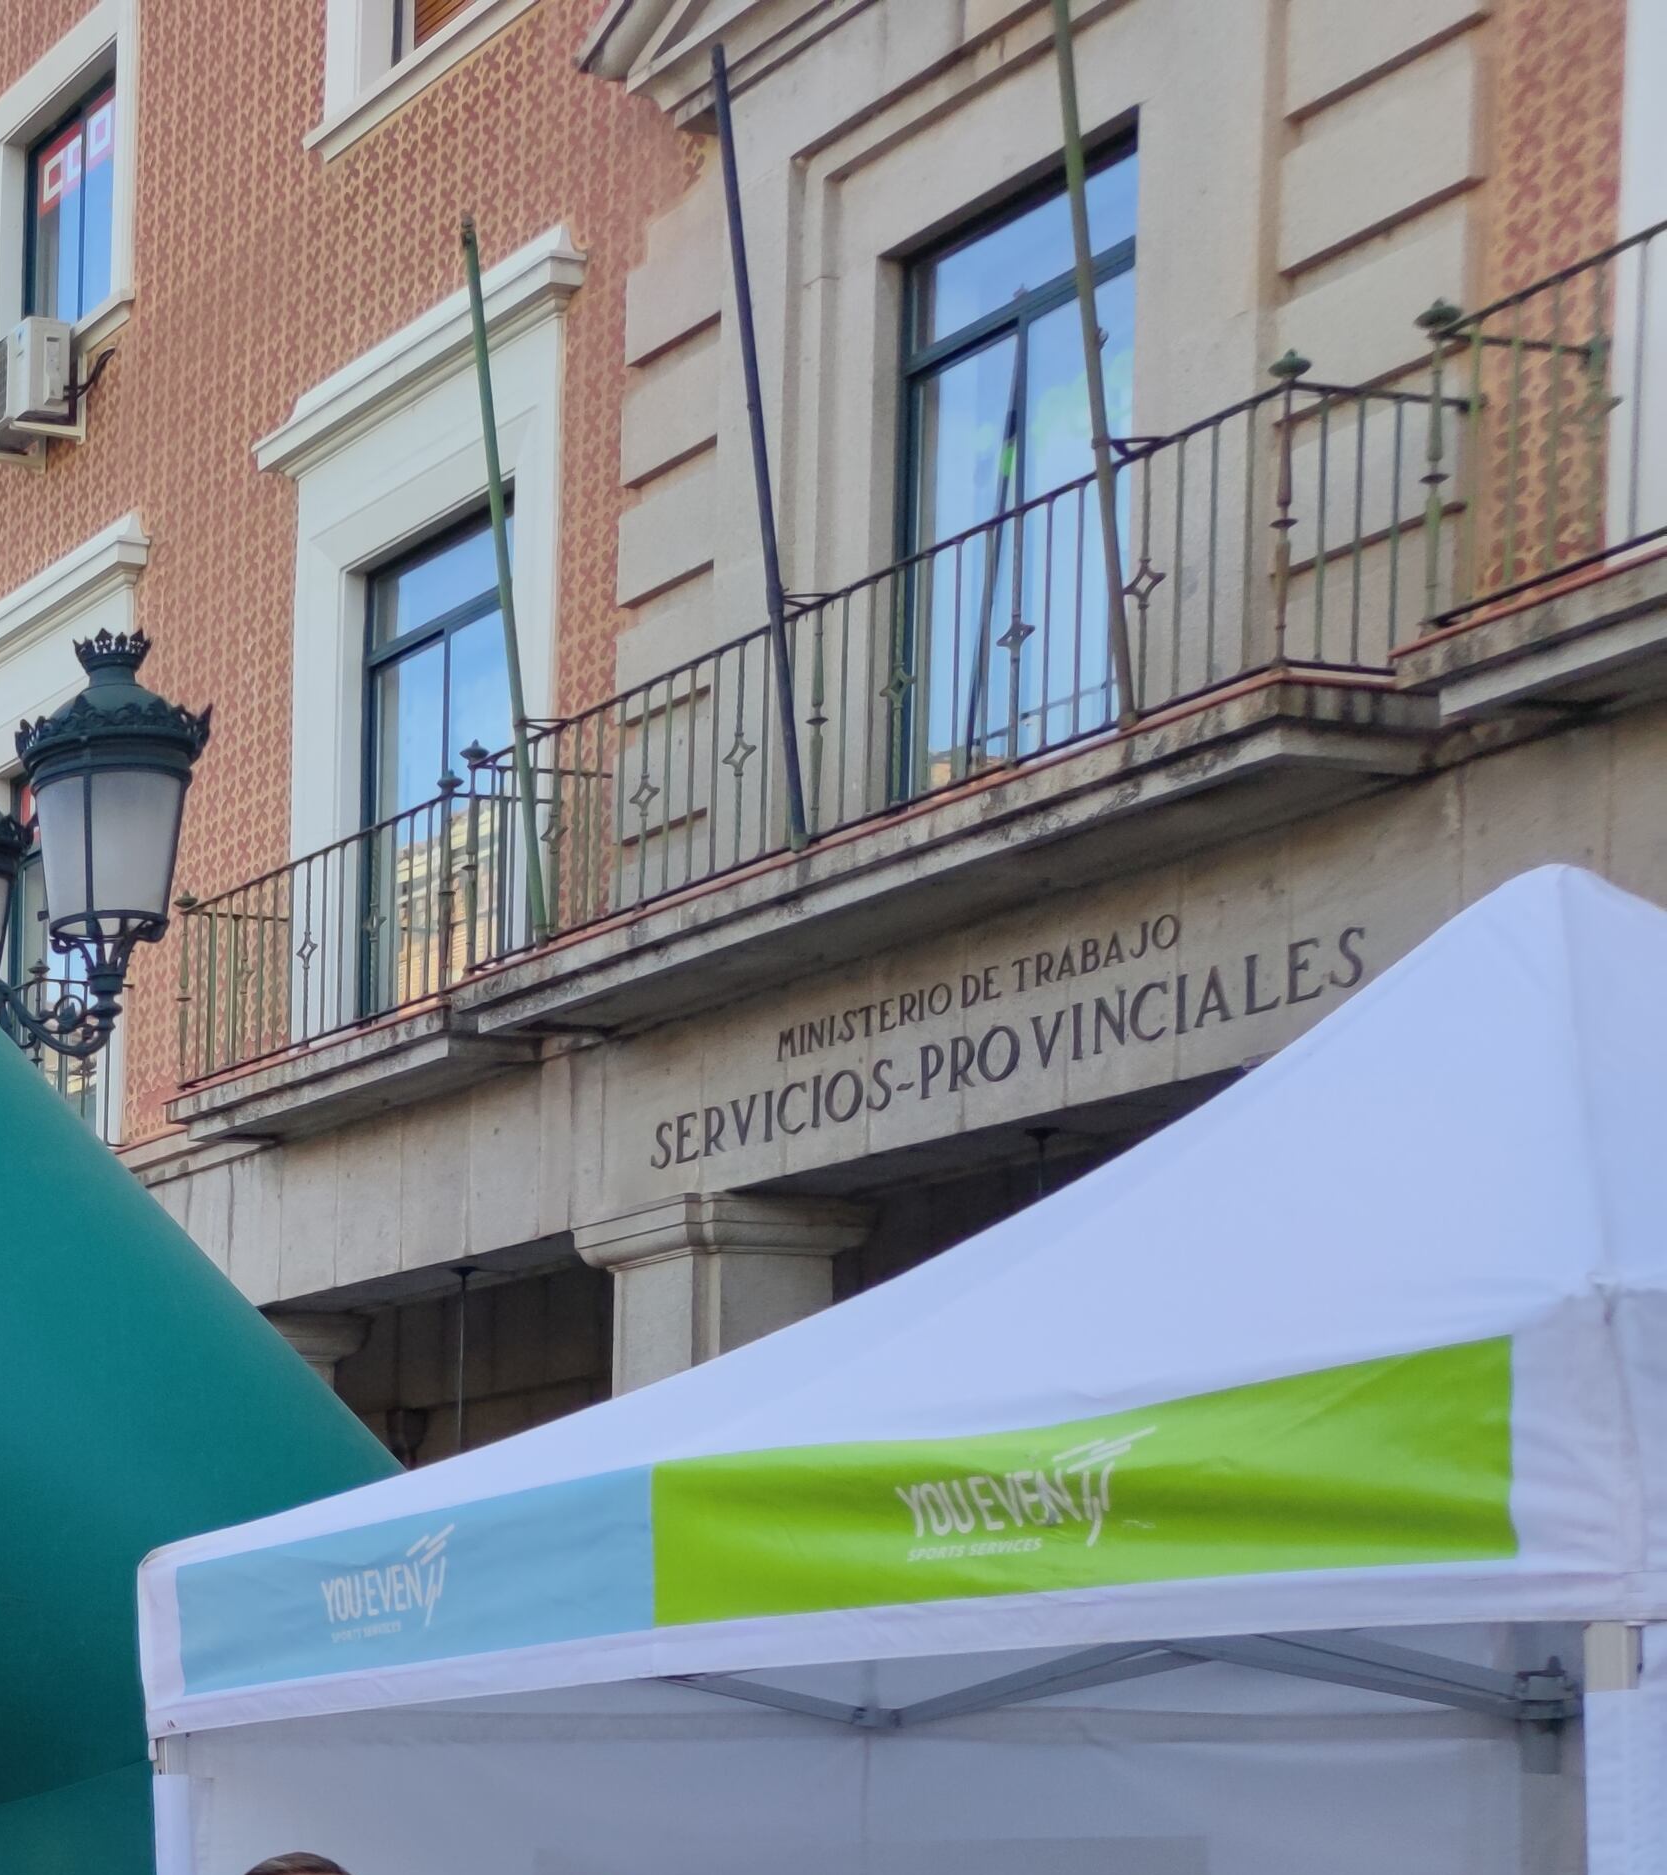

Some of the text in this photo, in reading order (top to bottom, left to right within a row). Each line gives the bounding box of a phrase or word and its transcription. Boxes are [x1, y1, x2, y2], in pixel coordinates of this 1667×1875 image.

[649, 926, 1366, 1170] SERVICIOS-PROVINCIALES
[777, 914, 1182, 1062] MINISTERIO DE TRABAJO
